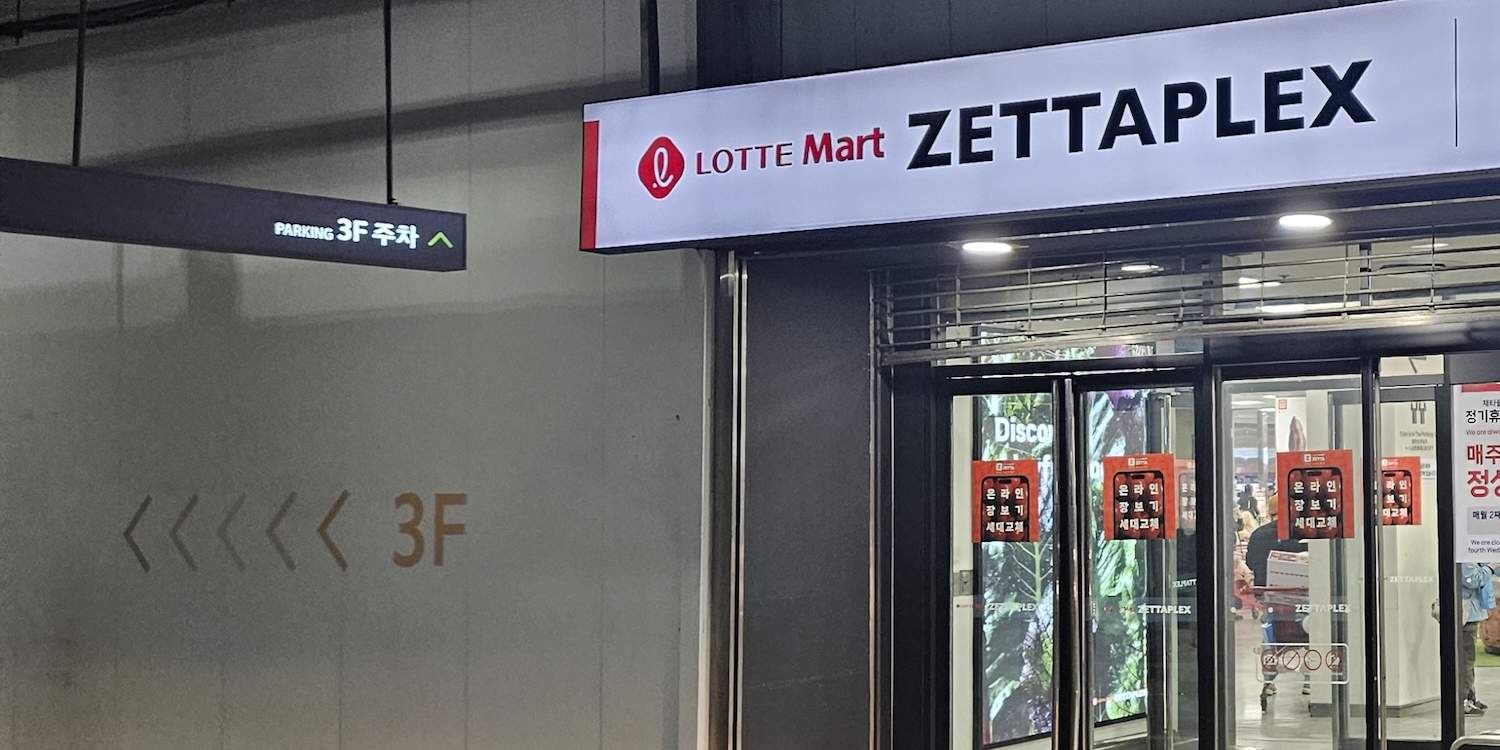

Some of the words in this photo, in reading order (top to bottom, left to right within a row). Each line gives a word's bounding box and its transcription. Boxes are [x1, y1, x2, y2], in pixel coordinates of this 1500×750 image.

[696, 142, 793, 175] LOTTE
[802, 127, 886, 165] Mart
[907, 59, 1375, 170] ZETTAPLEX
[274, 221, 335, 241] PARKING
[336, 217, 369, 243] 3F
[371, 222, 420, 249] 주차
[994, 417, 1053, 443] Disco
[1382, 508, 1408, 518] 대교체
[1473, 511, 1488, 519] 매월
[986, 521, 1024, 532] 세대교체
[1119, 518, 1160, 530] 세대교체
[1295, 517, 1338, 529] 세대교체
[391, 492, 468, 568] 3F
[1137, 604, 1192, 614] ZETTAPLEX
